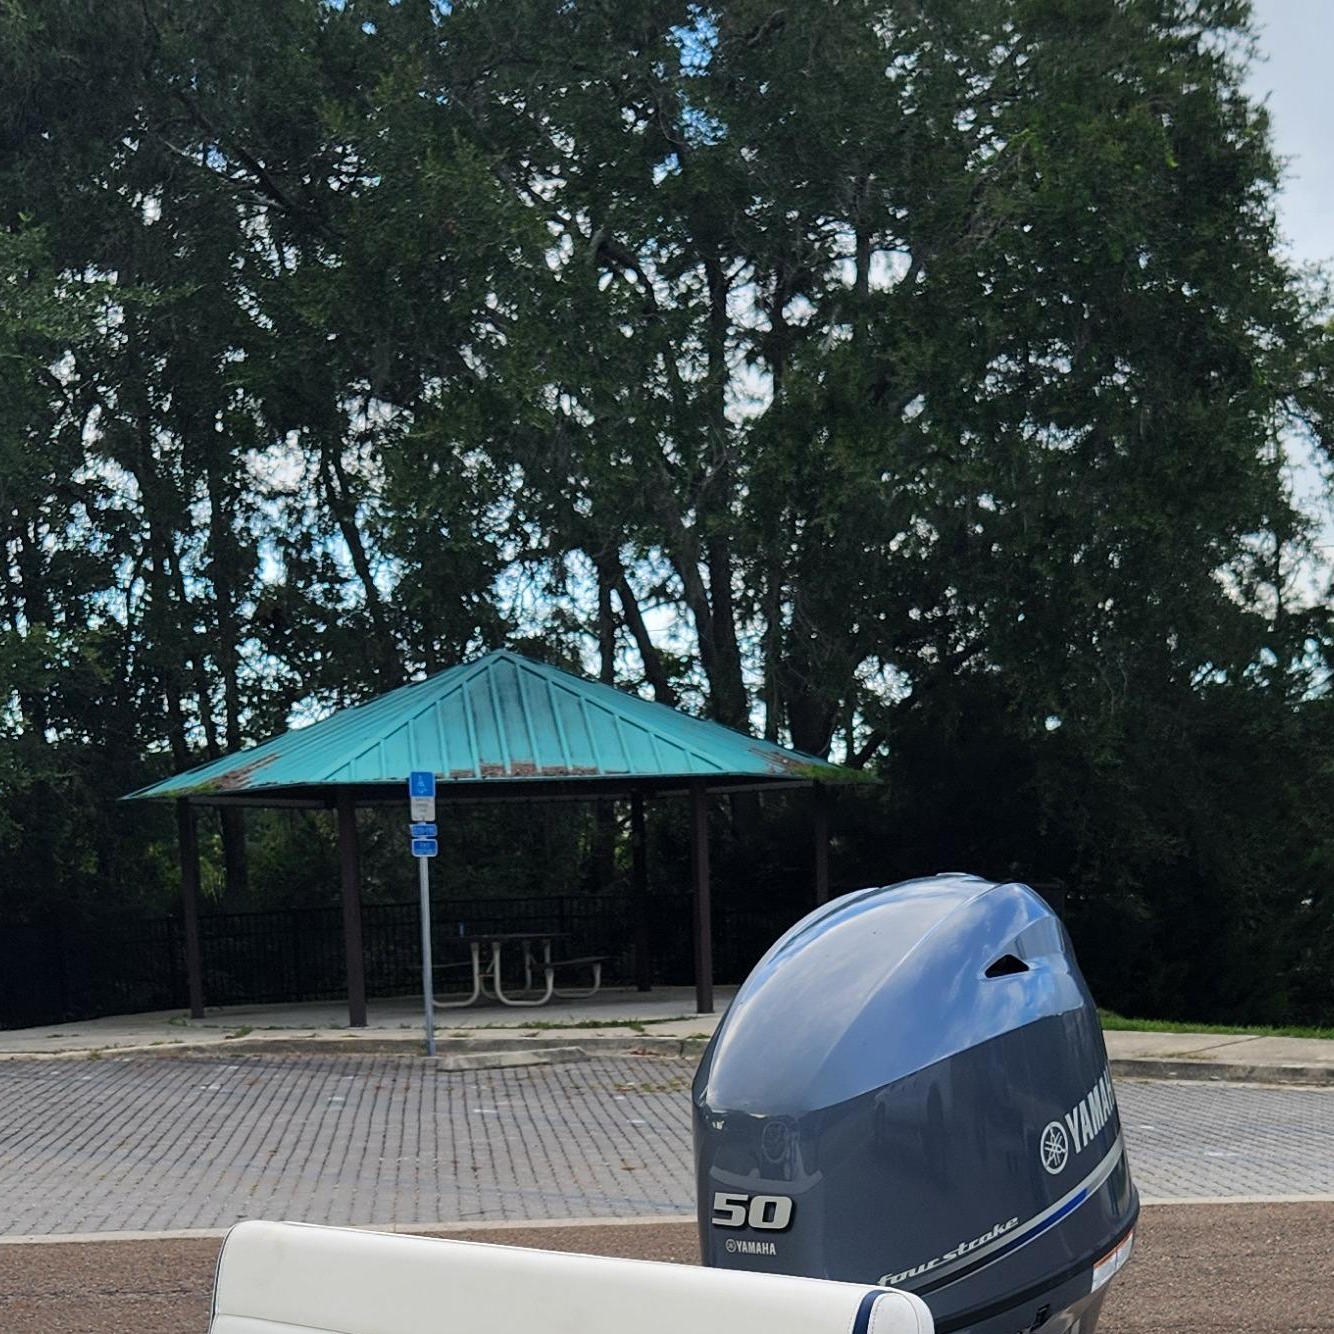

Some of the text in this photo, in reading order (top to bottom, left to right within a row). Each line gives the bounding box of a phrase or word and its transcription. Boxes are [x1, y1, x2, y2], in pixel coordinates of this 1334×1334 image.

[1064, 1064, 1116, 1154] YAMAH
[711, 1191, 794, 1230] 50
[735, 1240, 777, 1256] YAMAHA
